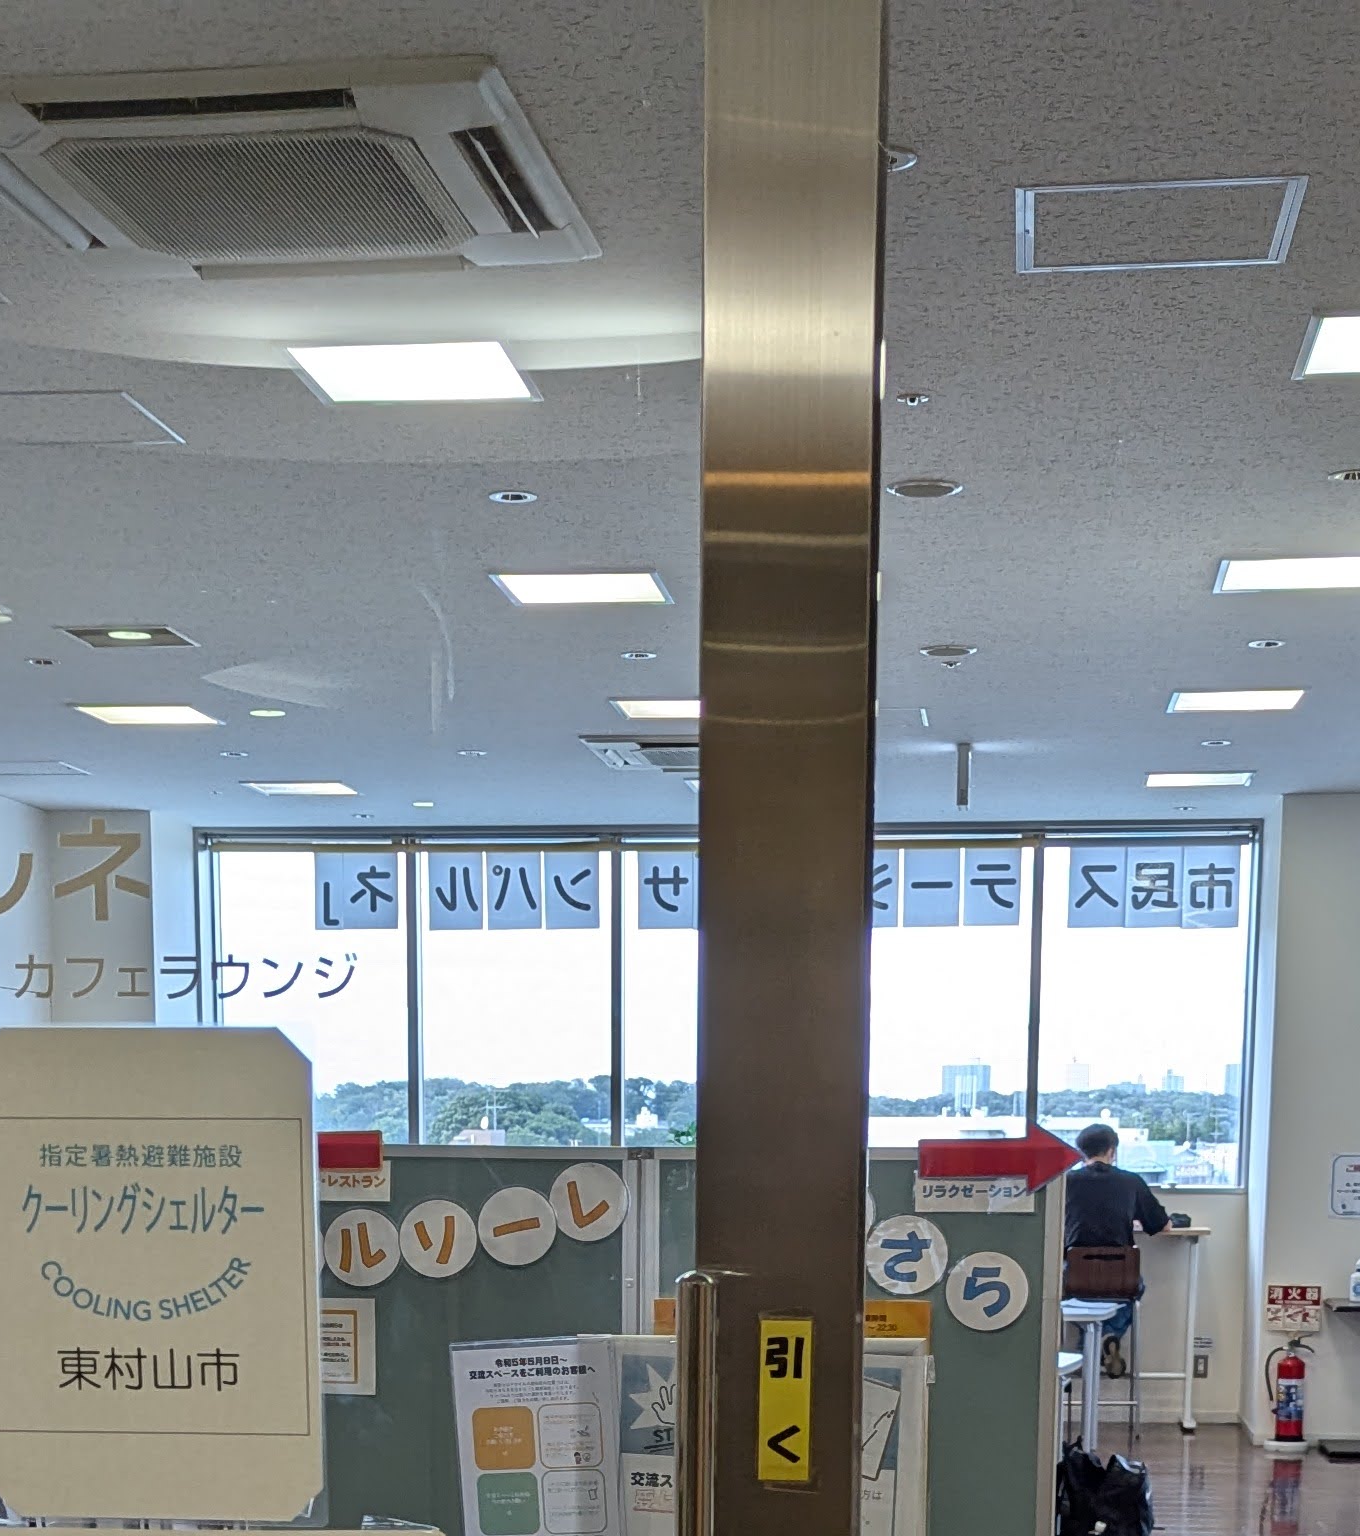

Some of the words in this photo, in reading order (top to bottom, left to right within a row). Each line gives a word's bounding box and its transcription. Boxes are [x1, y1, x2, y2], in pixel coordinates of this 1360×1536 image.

[14, 953, 359, 1000] カフェラウンジ
[39, 1143, 243, 1169] 指定暑熱避難施設
[22, 1182, 266, 1236] クーリングシェルター
[922, 1184, 1028, 1199] リラクゼーション
[40, 1259, 152, 1322] COOLING
[159, 1256, 252, 1321] SHELTER
[1269, 1286, 1320, 1301] 消火器
[57, 1347, 241, 1392] 東村山市
[764, 1335, 804, 1463] 引く
